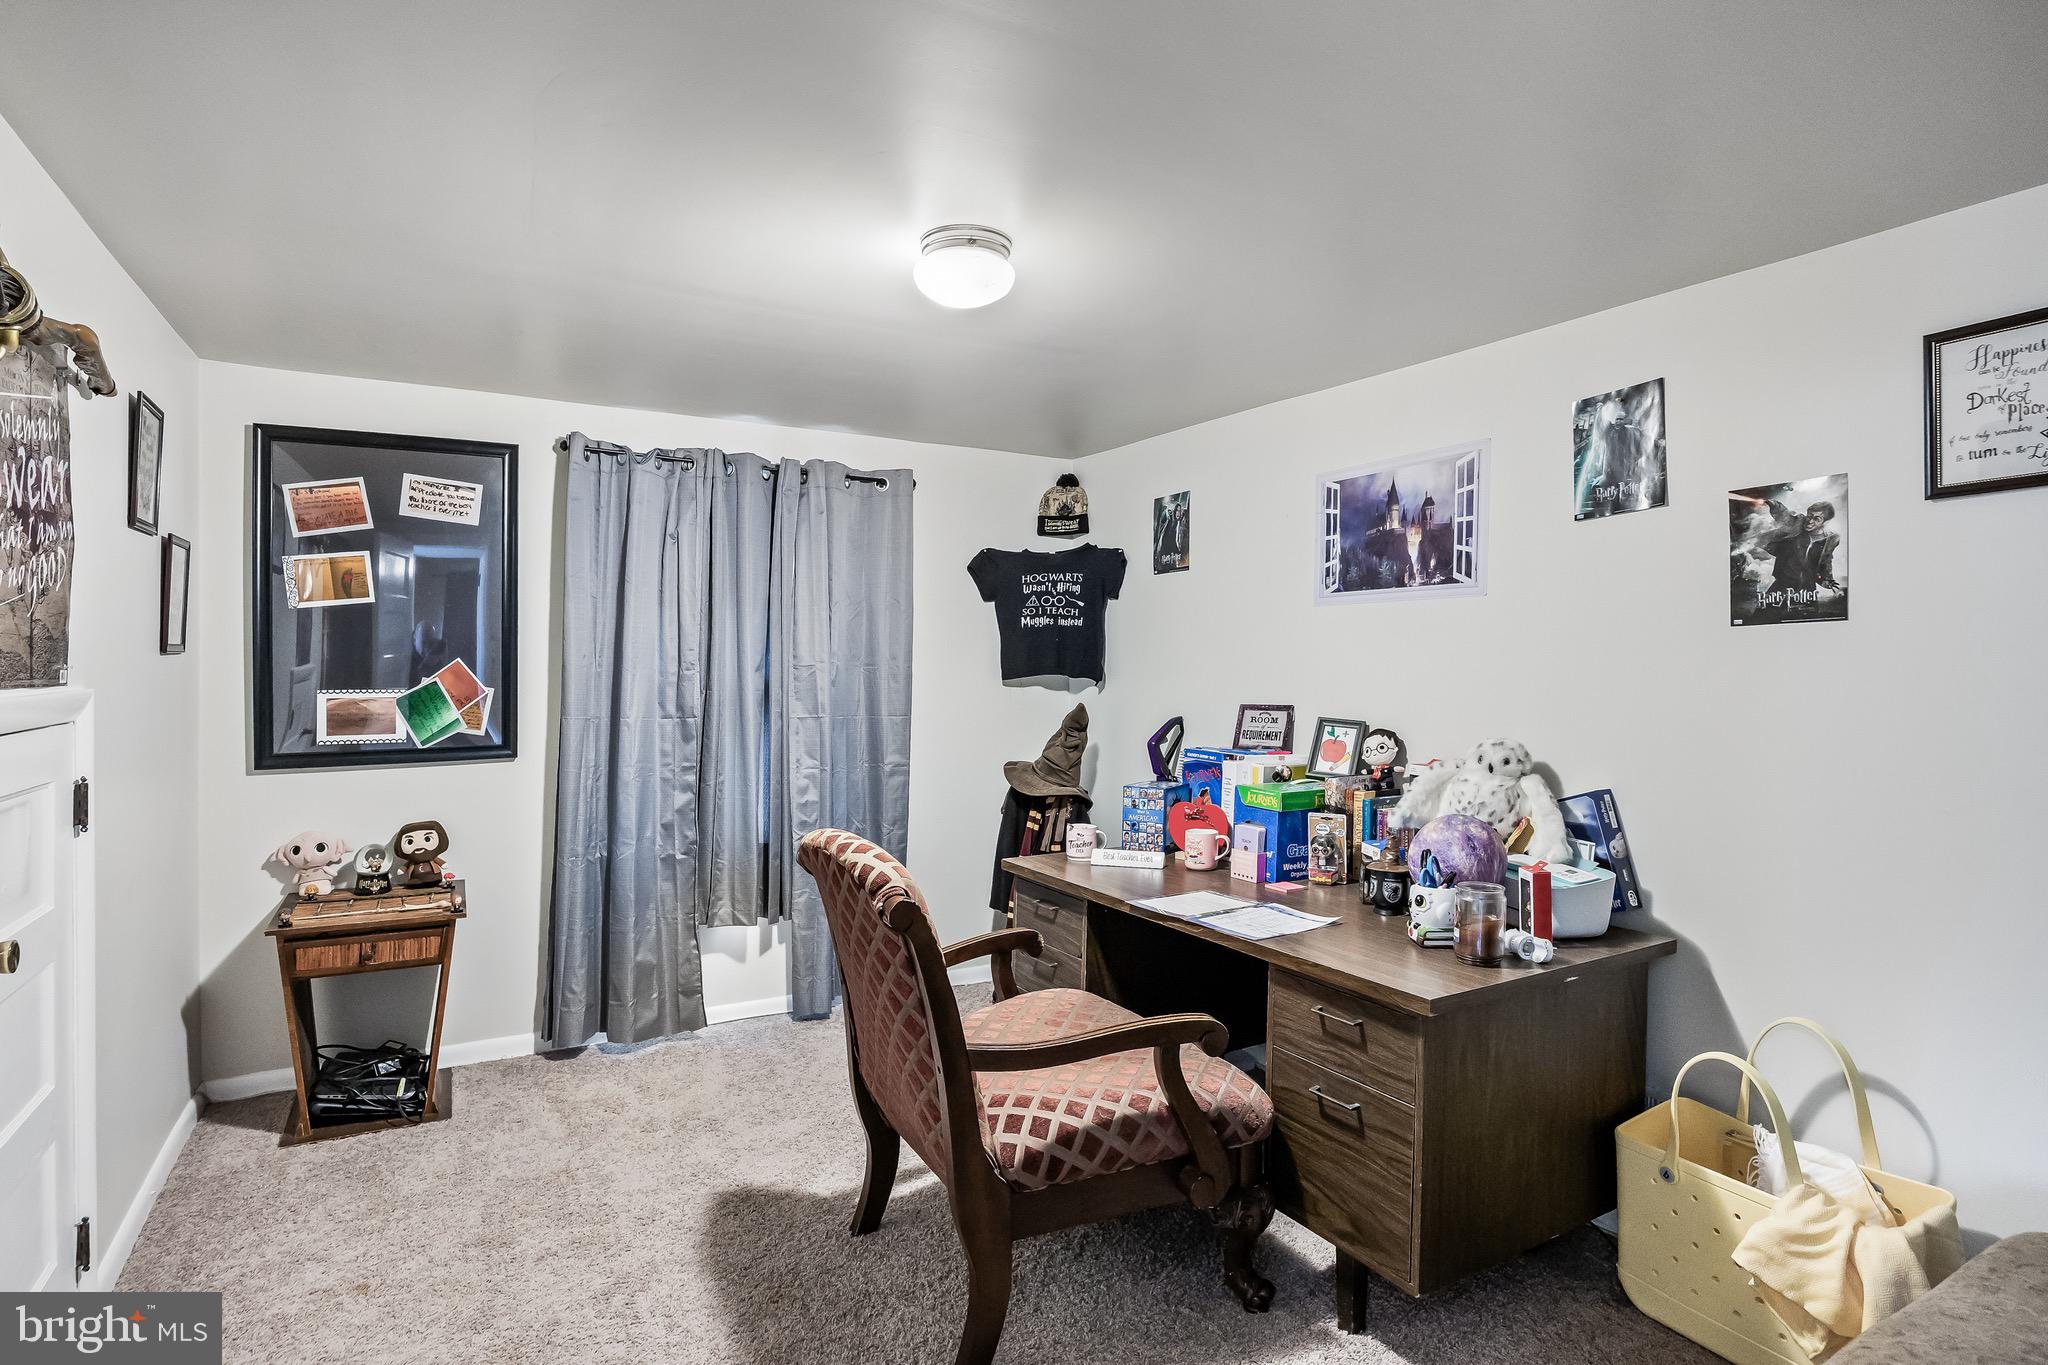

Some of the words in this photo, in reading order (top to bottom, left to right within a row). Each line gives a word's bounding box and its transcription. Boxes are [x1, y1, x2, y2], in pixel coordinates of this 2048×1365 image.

[1966, 338, 2048, 372] Happines
[1966, 382, 2032, 414] Darkest
[2007, 402, 2048, 424] place
[0, 446, 69, 510] wear
[1595, 485, 1618, 503] Harry
[1021, 573, 1083, 583] HOGWARTS
[1022, 582, 1052, 594] Wasn't
[1056, 582, 1080, 595] Hiring
[1757, 591, 1785, 609] Harry
[1785, 587, 1820, 612] Potter
[1022, 608, 1036, 616] SO
[1045, 607, 1079, 616] TEACH
[1021, 615, 1054, 629] Muggles
[1057, 616, 1084, 627] instead
[1250, 716, 1279, 724] ROOM
[1241, 729, 1282, 741] REQUIREMENT
[1246, 791, 1279, 808] JOURNEYS
[1068, 840, 1093, 849] Teacher
[1282, 861, 1307, 871] Weekly
